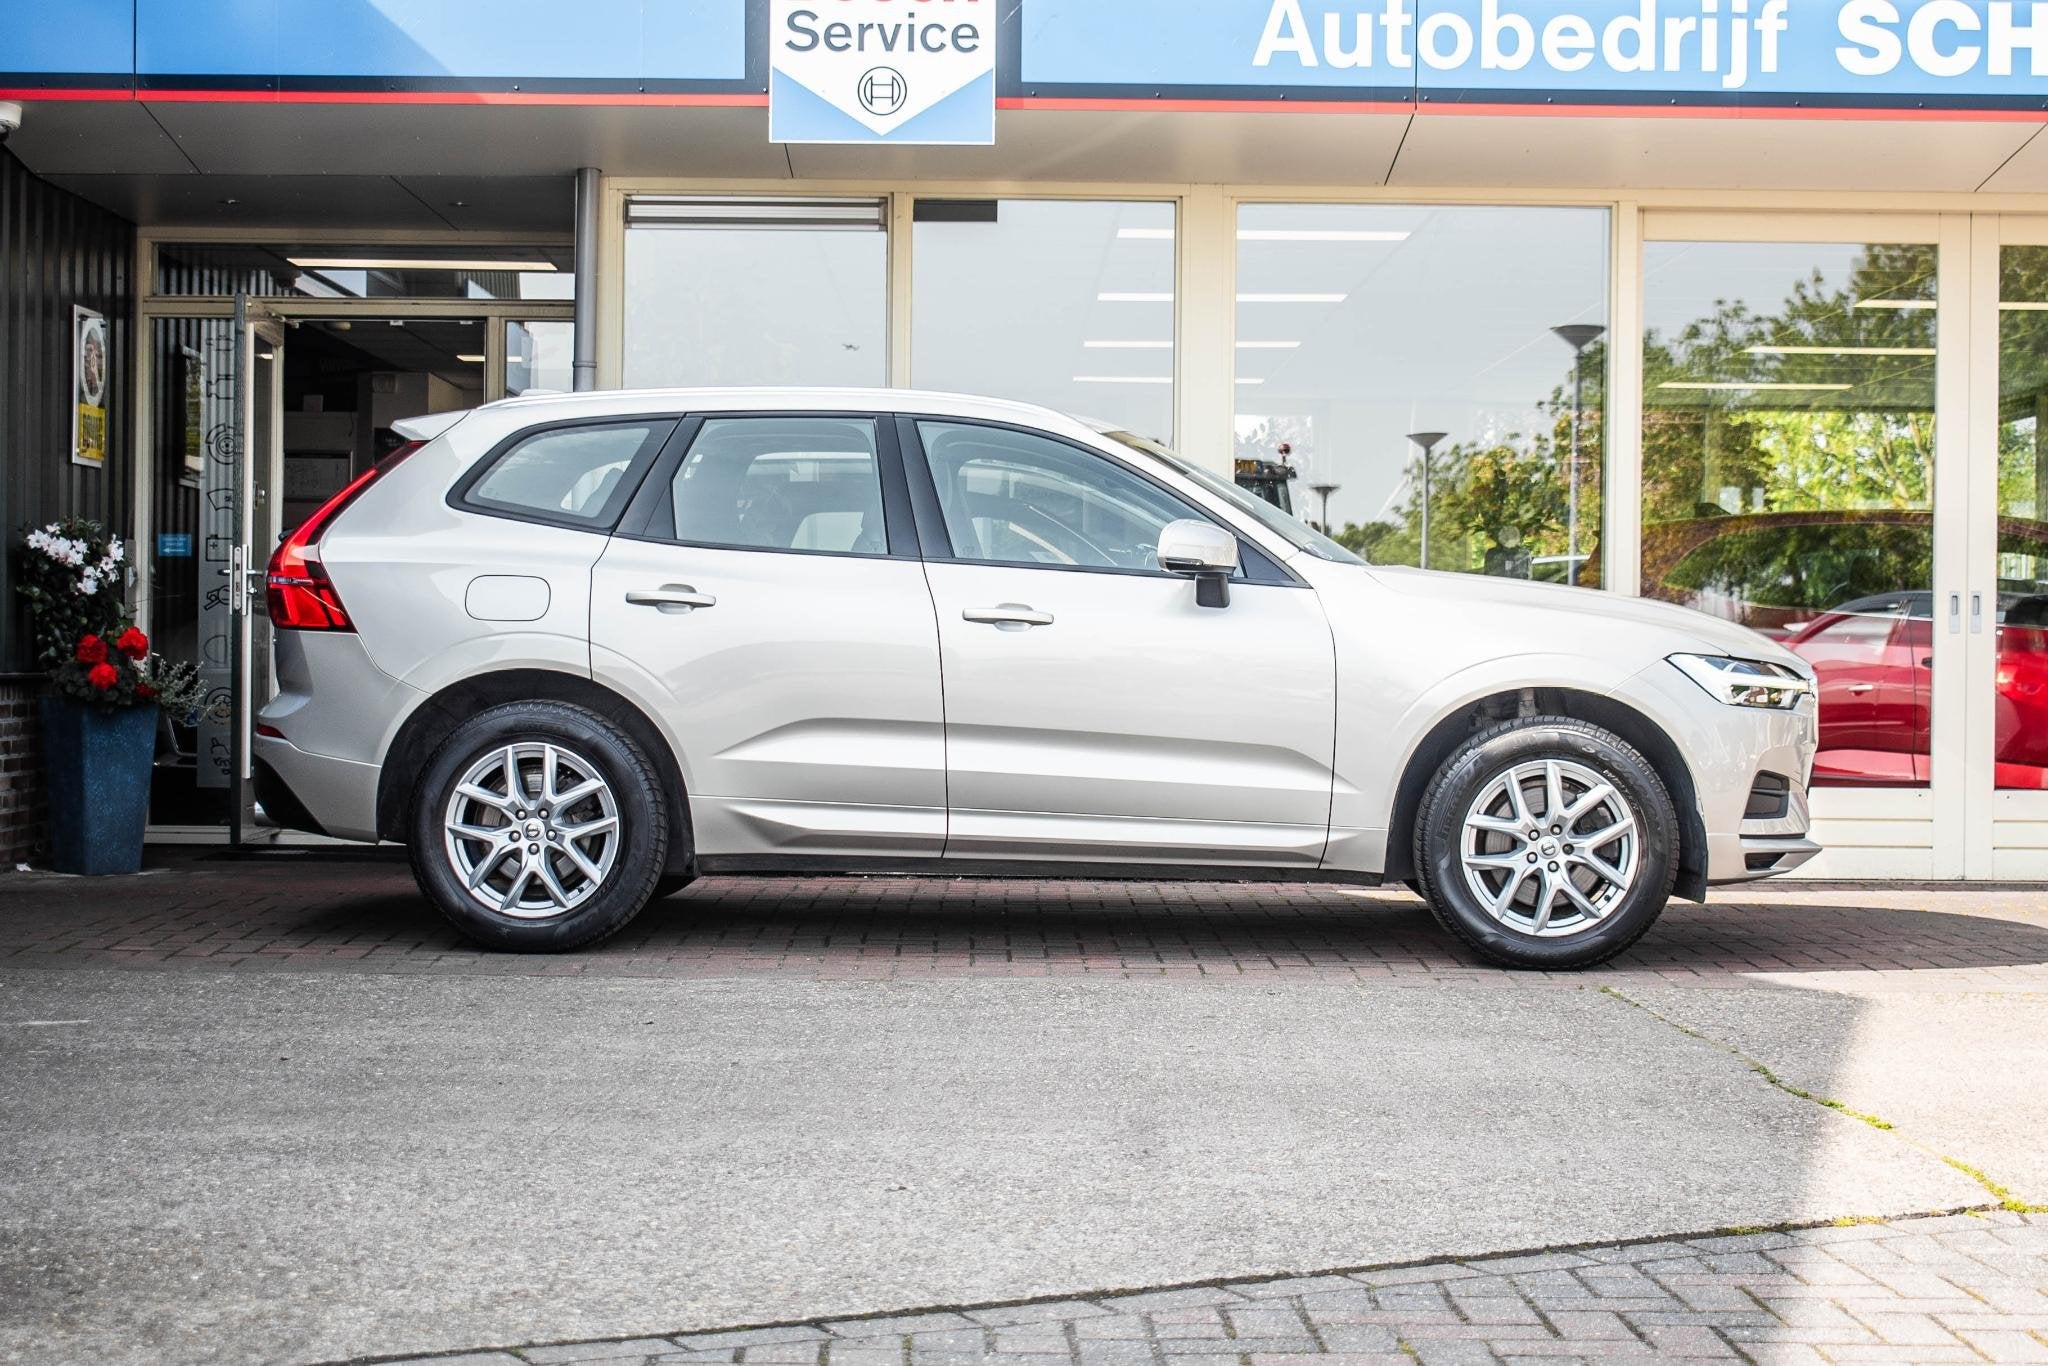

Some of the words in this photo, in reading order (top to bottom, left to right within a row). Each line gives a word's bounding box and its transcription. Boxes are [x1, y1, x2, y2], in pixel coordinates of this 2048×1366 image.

[785, 10, 979, 52] Service
[1252, 0, 1789, 88] Autobedrijf
[1835, 0, 2048, 77] SCH
